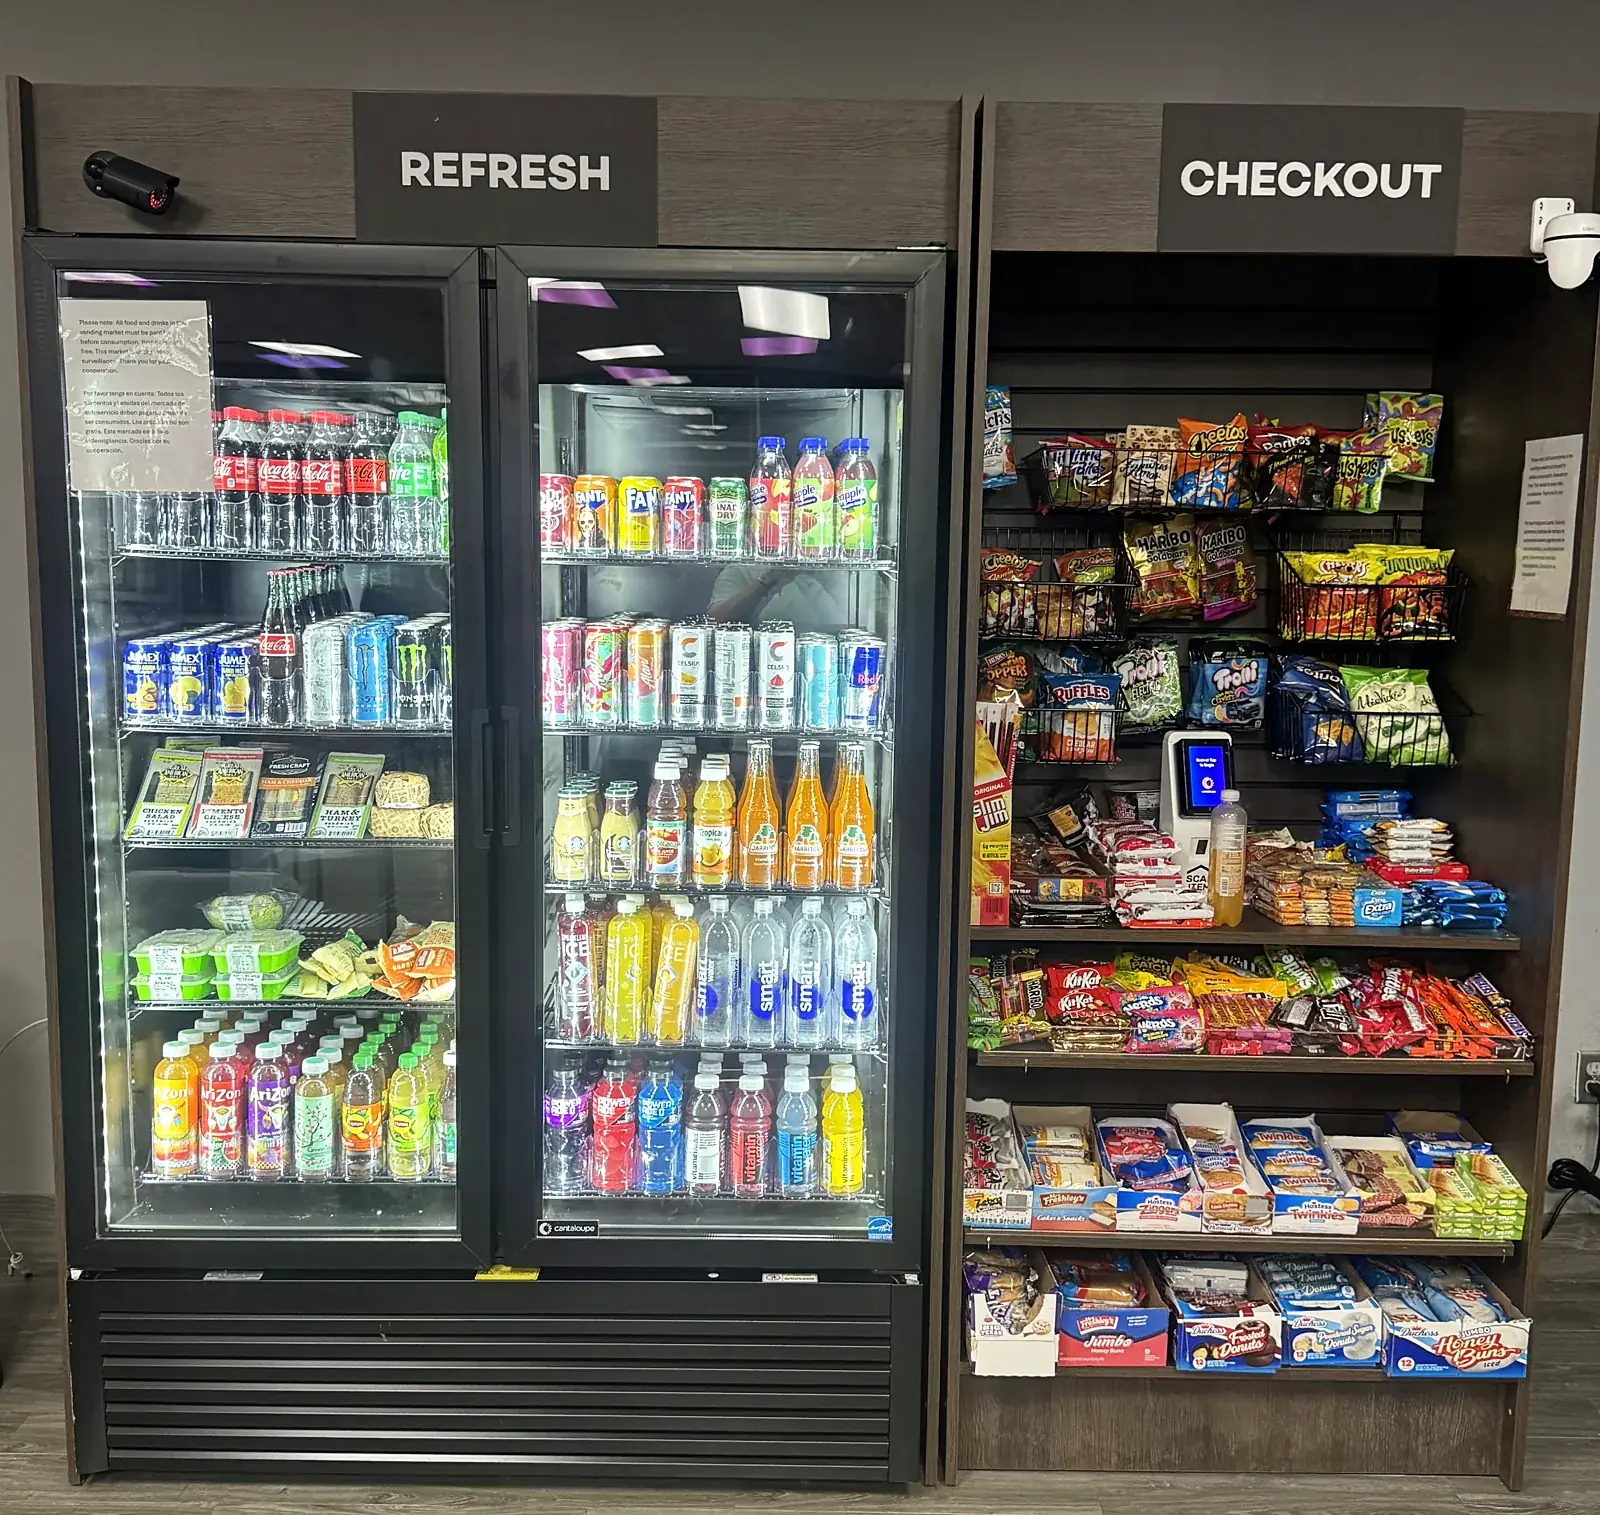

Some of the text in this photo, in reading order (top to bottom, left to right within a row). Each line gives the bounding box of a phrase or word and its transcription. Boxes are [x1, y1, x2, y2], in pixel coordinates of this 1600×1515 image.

[401, 151, 610, 191] REFRESH
[1180, 160, 1442, 199] CHECKOUT
[1188, 425, 1248, 457] Cheetos
[1262, 435, 1311, 452] Doritos
[716, 511, 736, 520] DRY
[1137, 528, 1192, 552] HARIBO
[1201, 526, 1247, 552] HARIBO
[1146, 549, 1189, 564] Goldbears
[1206, 546, 1244, 562] Goldbears
[1119, 651, 1168, 688] Trolli
[1213, 661, 1259, 691] Trolli
[1052, 684, 1110, 705] RUFFLES
[974, 782, 1005, 796] ORIGINAL
[1186, 875, 1207, 883] SCA
[1364, 902, 1392, 915] Extra
[562, 941, 589, 957] ICE
[1131, 954, 1169, 965] SOUR
[1130, 960, 1173, 974] PATCH
[758, 961, 774, 1013] smart
[800, 961, 813, 1013] smart
[851, 961, 866, 1014] smart
[1026, 979, 1043, 1009] HARIBO
[551, 1098, 581, 1107] POWER
[597, 1098, 631, 1108] POWER
[642, 1100, 672, 1108] POWER
[1259, 1131, 1307, 1142] Twinkies
[756, 1131, 766, 1168] water
[744, 1134, 757, 1182] vitamin
[790, 1134, 803, 1182] vitamin
[1269, 1156, 1321, 1165] Twinkies
[1284, 1177, 1334, 1185] Twinkies
[1042, 1195, 1084, 1206] Freshley's
[1147, 1197, 1173, 1206] Hostess
[1139, 1204, 1181, 1217] Zingers
[1290, 1208, 1346, 1221] Twinkies
[554, 1225, 595, 1233] cantaloupe
[1298, 1272, 1332, 1282] Donuts
[1303, 1284, 1338, 1296] Donuts
[1079, 1317, 1115, 1329] Freshley's
[1192, 1325, 1226, 1335] Duchess
[1294, 1319, 1326, 1328] Duchess
[1229, 1328, 1266, 1345] Frosted
[1317, 1324, 1374, 1343] Powdered Sugar
[1400, 1328, 1439, 1337] Duchess
[1460, 1326, 1491, 1338] JUMBO
[1083, 1334, 1132, 1348] Jumbo
[1324, 1336, 1356, 1349] Donuts
[1438, 1333, 1502, 1354] Honey
[1218, 1339, 1264, 1358] Donuts
[1400, 1359, 1412, 1367] 12
[1453, 1347, 1507, 1369] Buns
